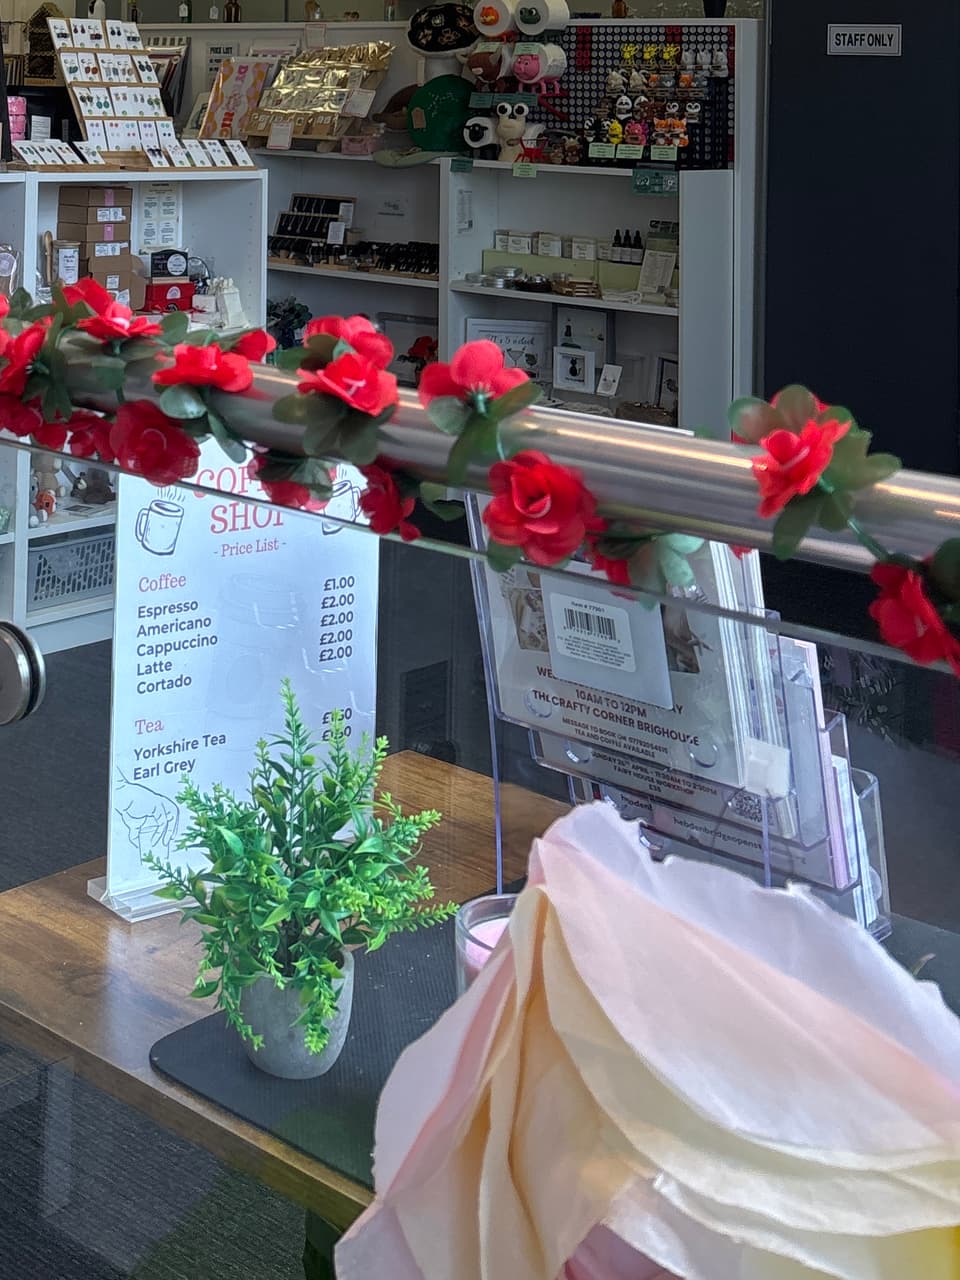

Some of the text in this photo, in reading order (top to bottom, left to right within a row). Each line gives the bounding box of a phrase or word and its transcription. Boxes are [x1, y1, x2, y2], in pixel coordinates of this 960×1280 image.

[834, 32, 894, 47] STAFF ONLY
[221, 542, 253, 558] Price
[256, 538, 280, 553] List
[137, 576, 355, 618] Espresso £1.00
[138, 573, 187, 593] Coffee
[136, 593, 355, 637] Americano £2.00
[136, 611, 354, 657] Cappuccino £2.00
[137, 629, 353, 676] Latte £2.00
[136, 646, 353, 694] Cortado £2.00
[575, 688, 647, 718] 10AM TO 12PM
[134, 718, 164, 735] Tea
[551, 696, 590, 715] CRAFTY
[593, 708, 636, 728] CORNER
[637, 720, 700, 746] BRIGHOUSE
[133, 739, 199, 761] Yorkshire
[202, 734, 227, 748] Tea
[586, 732, 599, 741] AND
[623, 742, 655, 759] AVAILABLE
[133, 764, 160, 780] Earl
[163, 758, 196, 775] Grey
